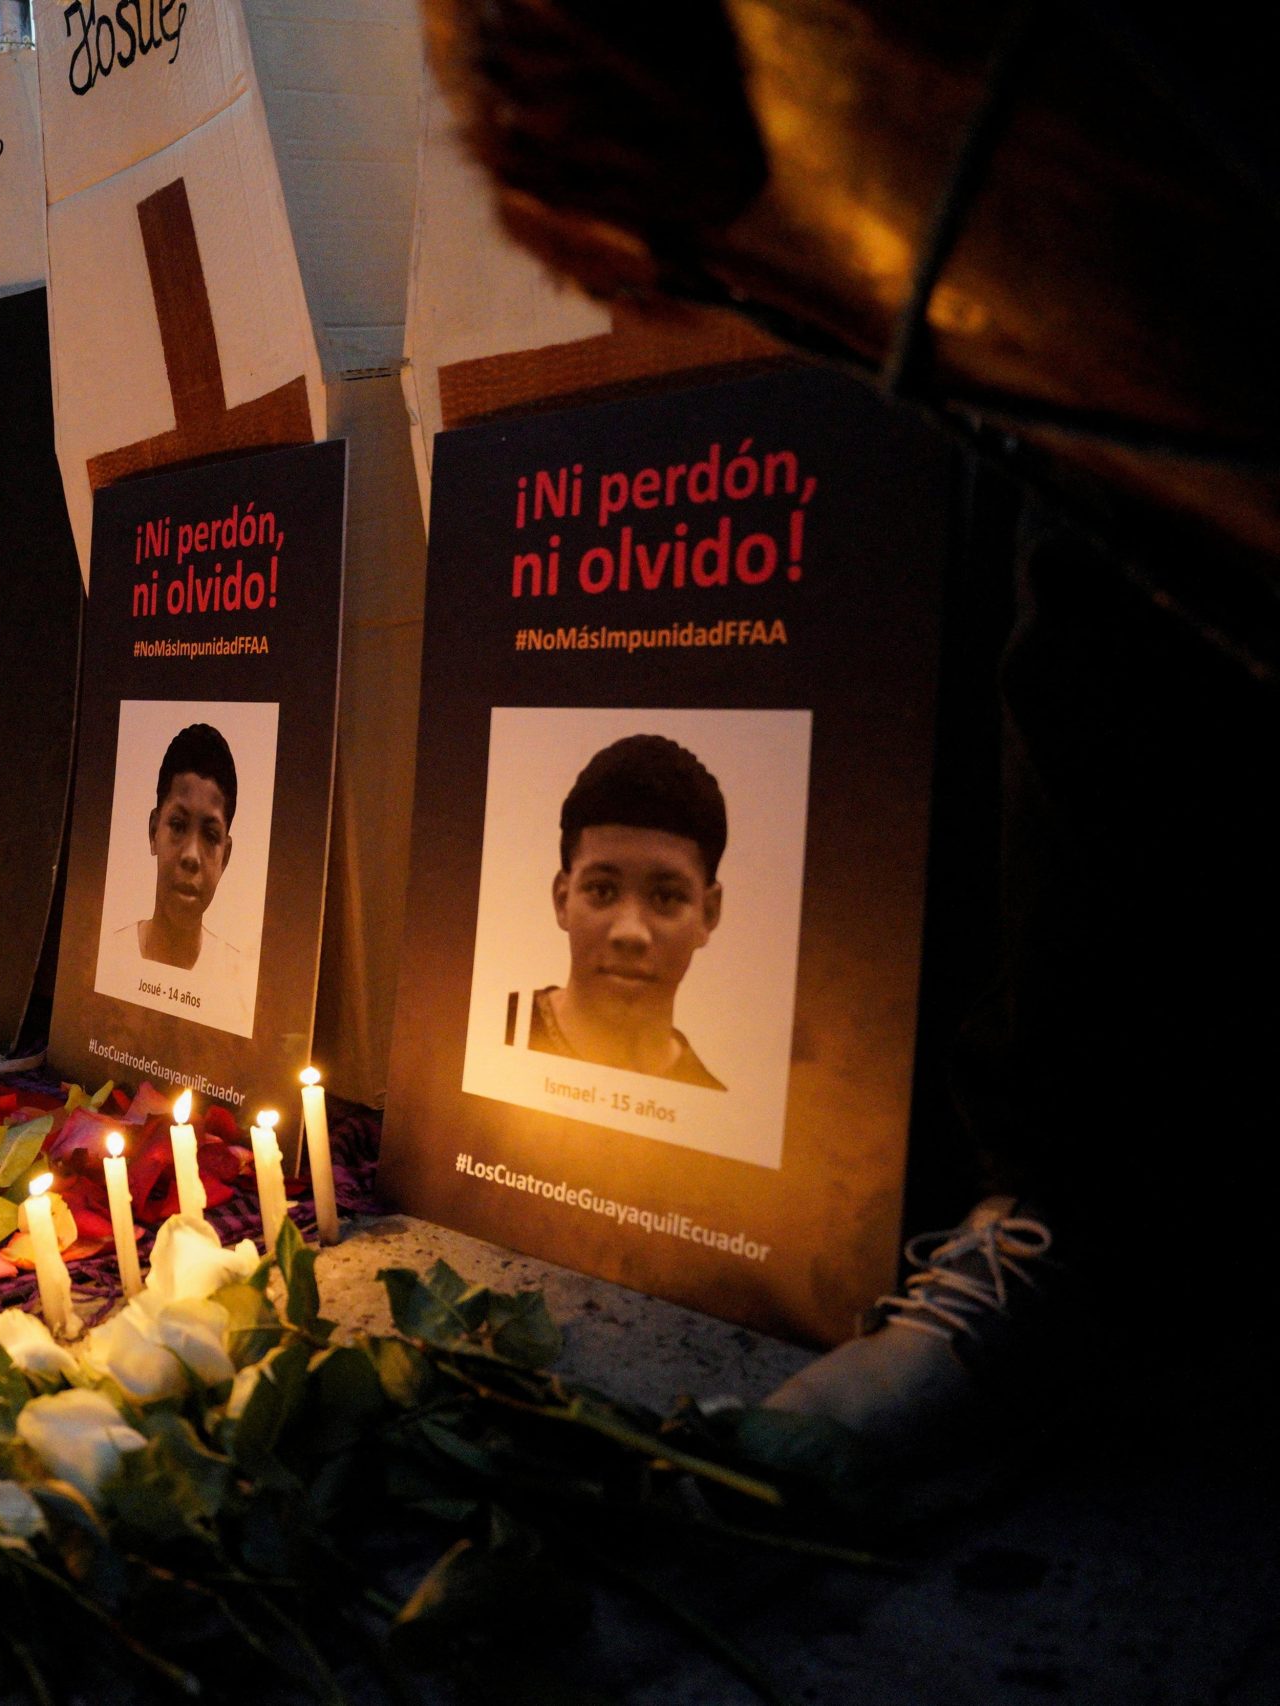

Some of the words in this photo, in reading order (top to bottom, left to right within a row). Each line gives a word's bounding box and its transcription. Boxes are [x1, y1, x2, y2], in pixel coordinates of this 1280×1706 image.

[516, 463, 584, 529] ¡Ni
[598, 437, 817, 527] perdón,
[135, 516, 171, 565] ¡Ni
[177, 501, 285, 565] perdón,
[511, 534, 561, 598] ni
[578, 510, 805, 594] olvido!
[132, 569, 159, 617] ni
[166, 555, 279, 616] olvido!
[133, 635, 269, 660] #NoMásImpunidadFFAA
[515, 619, 789, 654] #NoMásImpunidadFFAA
[138, 978, 161, 998] Josué
[168, 986, 179, 1002] 14
[180, 990, 201, 1009] años
[544, 1076, 596, 1106] Ismael
[611, 1092, 631, 1112] 15
[635, 1098, 677, 1124] años
[455, 1152, 773, 1263] #LosCuatrodeGuayaquilEcuador
